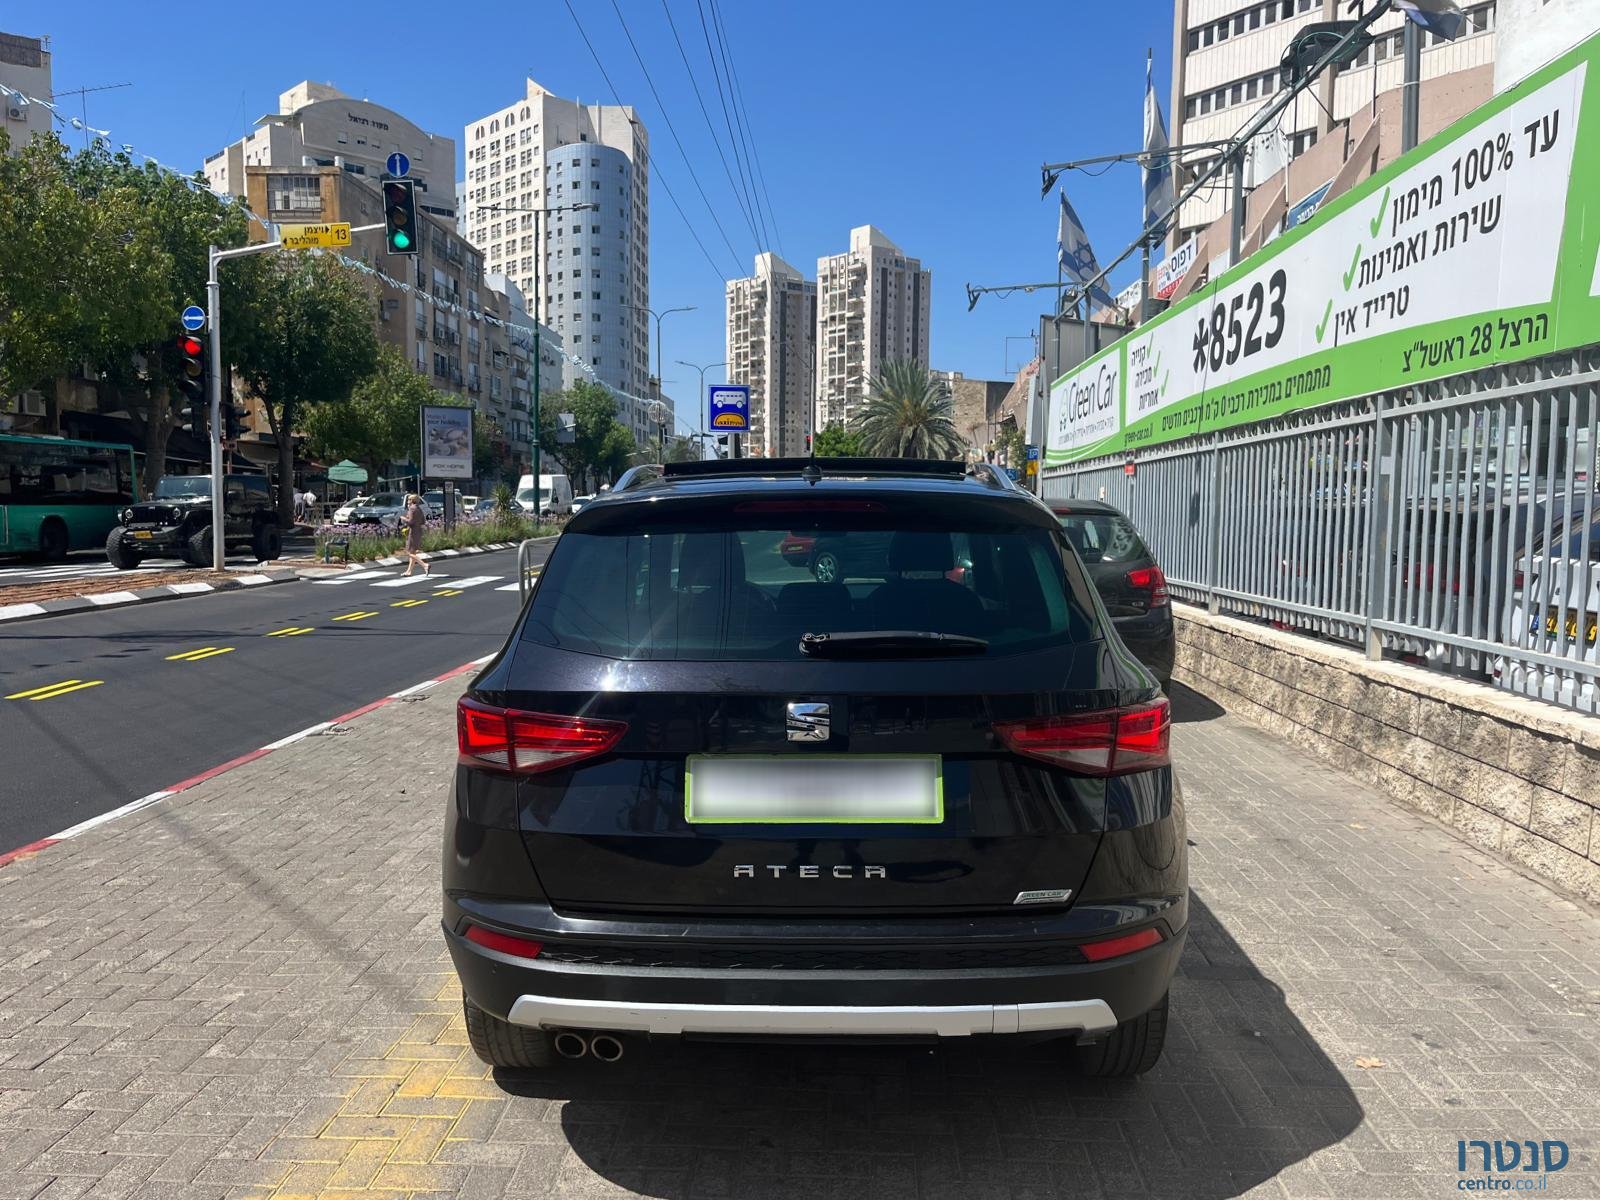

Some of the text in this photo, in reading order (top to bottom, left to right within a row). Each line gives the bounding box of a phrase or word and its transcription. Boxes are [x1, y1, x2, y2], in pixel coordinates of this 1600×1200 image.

[1391, 109, 1559, 237] עד 100% מימון
[334, 229, 347, 240] 13
[1358, 194, 1502, 289] שירות ואמינות
[1171, 244, 1192, 272] דפוס
[1334, 284, 1410, 347] טרייד אין
[1470, 322, 1493, 356] 28
[1498, 312, 1548, 350] הרצל
[1131, 345, 1146, 367] קנייה
[1135, 366, 1152, 388] מכירה
[1285, 364, 1331, 398] מתמחים
[1068, 363, 1117, 423] Green Car
[1138, 388, 1159, 411] אחריות
[1228, 393, 1245, 414] רכבי
[1246, 380, 1282, 409] במכירת
[1161, 412, 1182, 431] חדשים
[733, 864, 886, 879] ATECA
